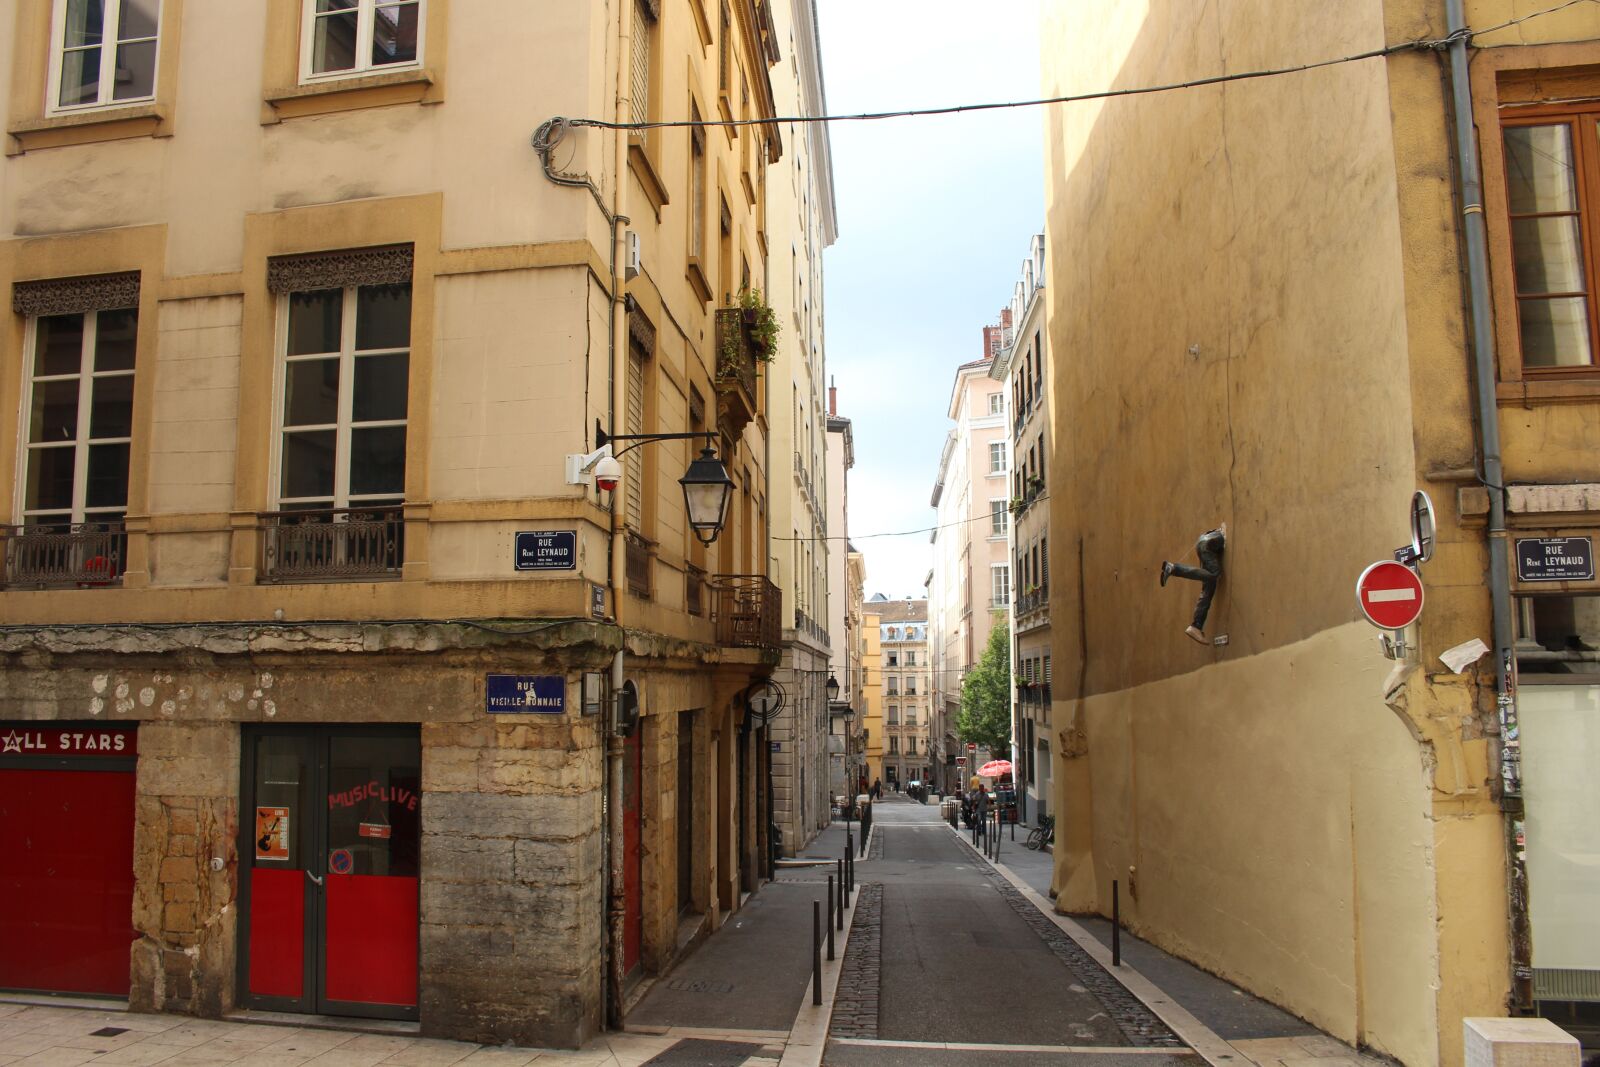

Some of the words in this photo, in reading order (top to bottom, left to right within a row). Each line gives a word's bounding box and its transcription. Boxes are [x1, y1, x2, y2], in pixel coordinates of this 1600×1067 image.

[538, 538, 553, 547] RUE
[537, 547, 569, 557] LEYNAUD
[1545, 546, 1563, 555] RUE
[1545, 556, 1584, 566] LEYNAUD
[517, 681, 535, 691] RUE
[2, 729, 47, 752] ALL
[59, 733, 126, 751] STARS
